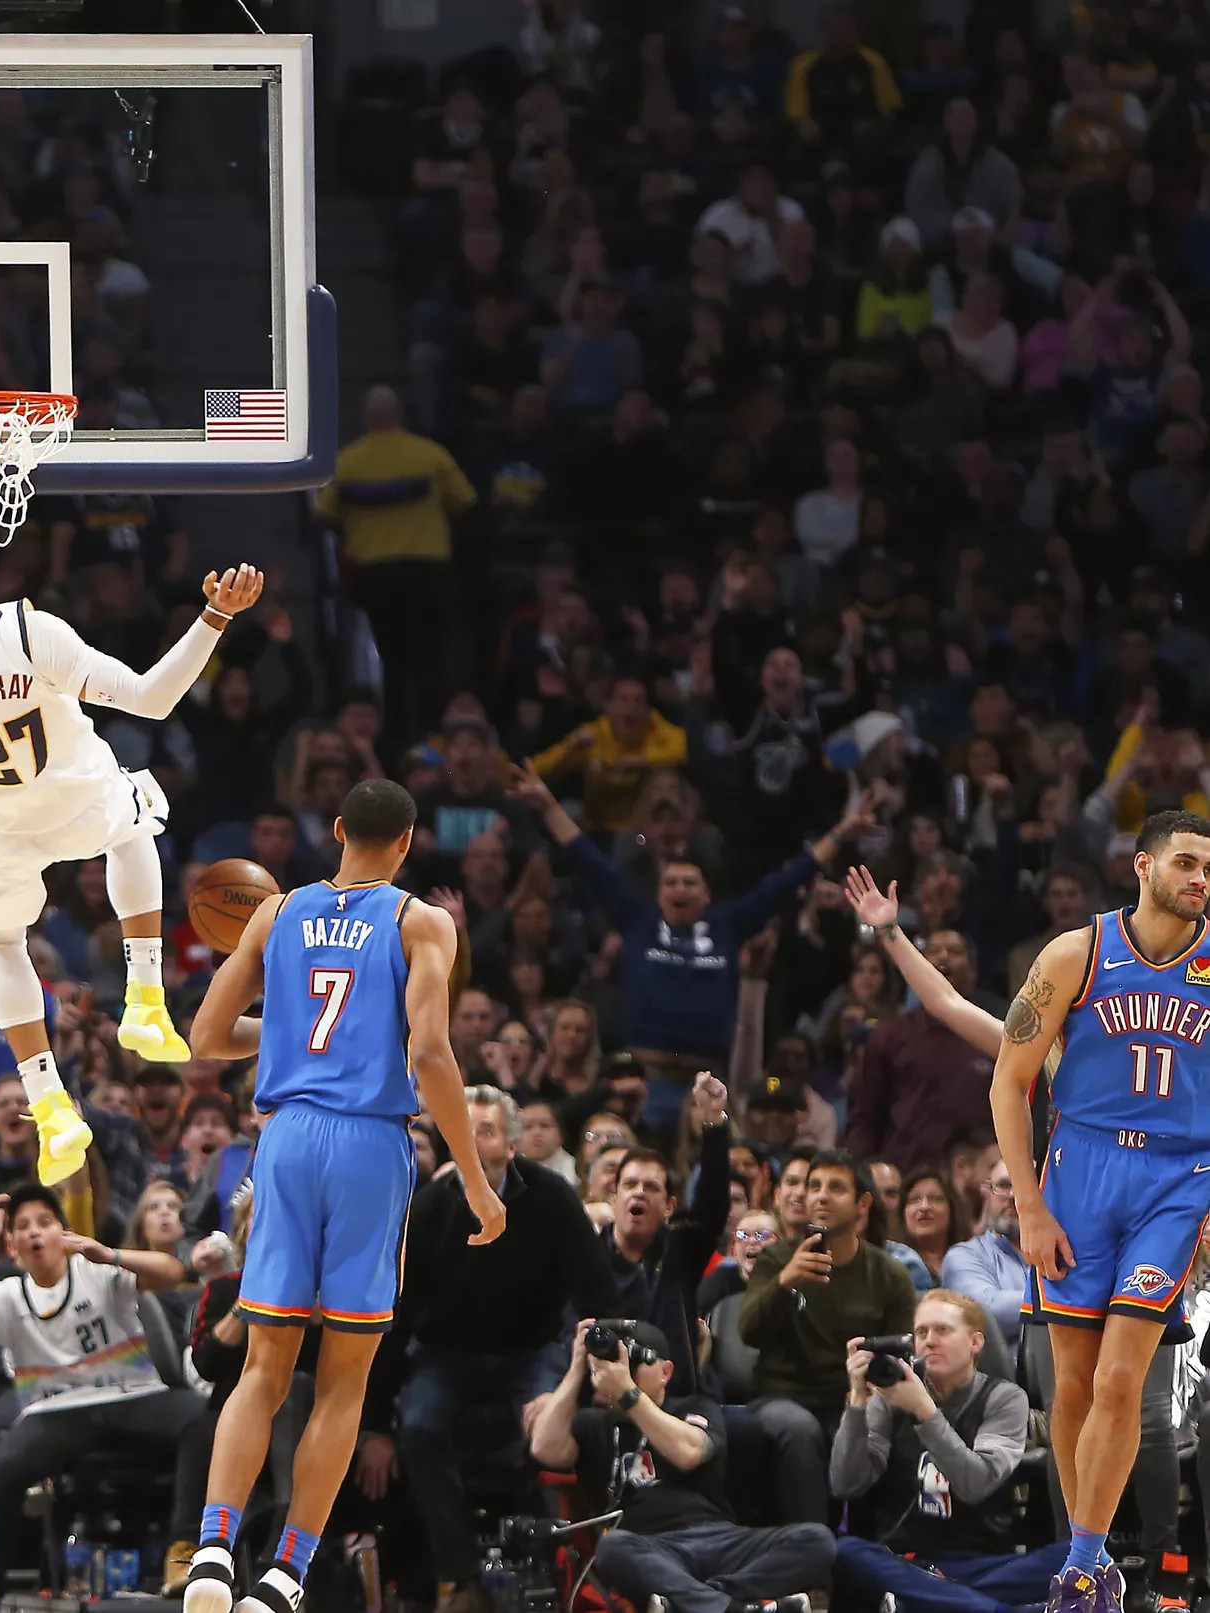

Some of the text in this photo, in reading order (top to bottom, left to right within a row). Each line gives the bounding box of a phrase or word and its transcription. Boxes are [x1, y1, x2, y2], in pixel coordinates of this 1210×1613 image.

[301, 917, 375, 951] BAZLEY
[308, 967, 355, 1054] 7
[1093, 991, 1210, 1047] THUNDER
[1129, 1043, 1175, 1099] 11
[1117, 1129, 1146, 1149] OKC
[75, 1316, 110, 1355] 27
